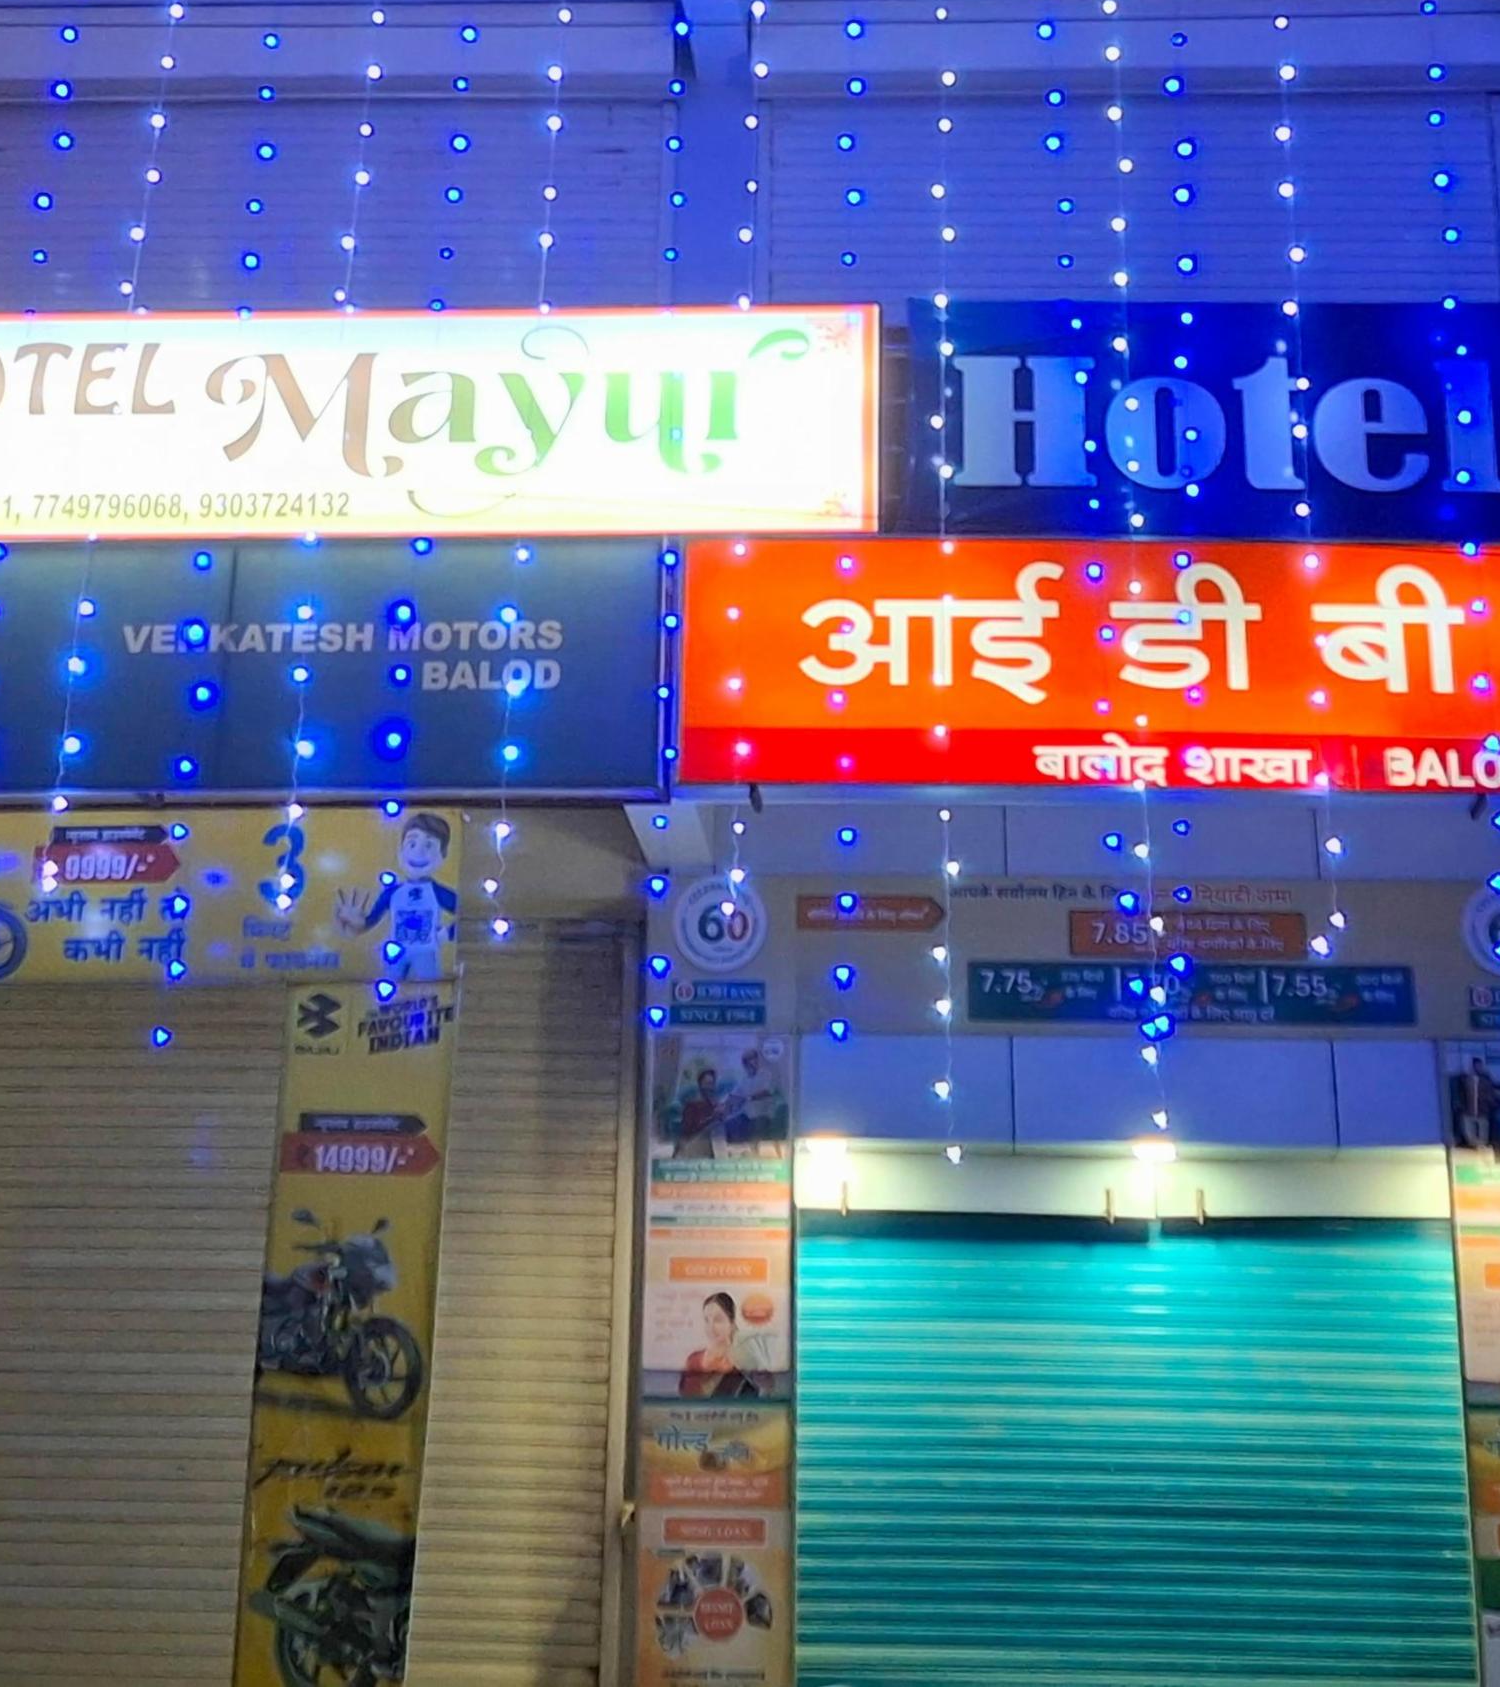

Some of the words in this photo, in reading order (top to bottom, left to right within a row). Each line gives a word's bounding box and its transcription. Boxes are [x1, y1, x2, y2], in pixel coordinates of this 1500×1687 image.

[32, 493, 190, 524] 7749796068,
[199, 492, 350, 519] 9303724132
[388, 620, 563, 652] MOTORS
[799, 562, 1064, 704] आई
[1109, 563, 1262, 691] डी
[1311, 564, 1466, 693] बी
[421, 659, 561, 691] BALOD
[1033, 733, 1169, 786] बालोद
[1185, 748, 1311, 785] शाखा
[257, 823, 306, 909] 3
[25, 889, 87, 923] अभी
[698, 904, 750, 943] 60
[63, 928, 127, 962] कभी
